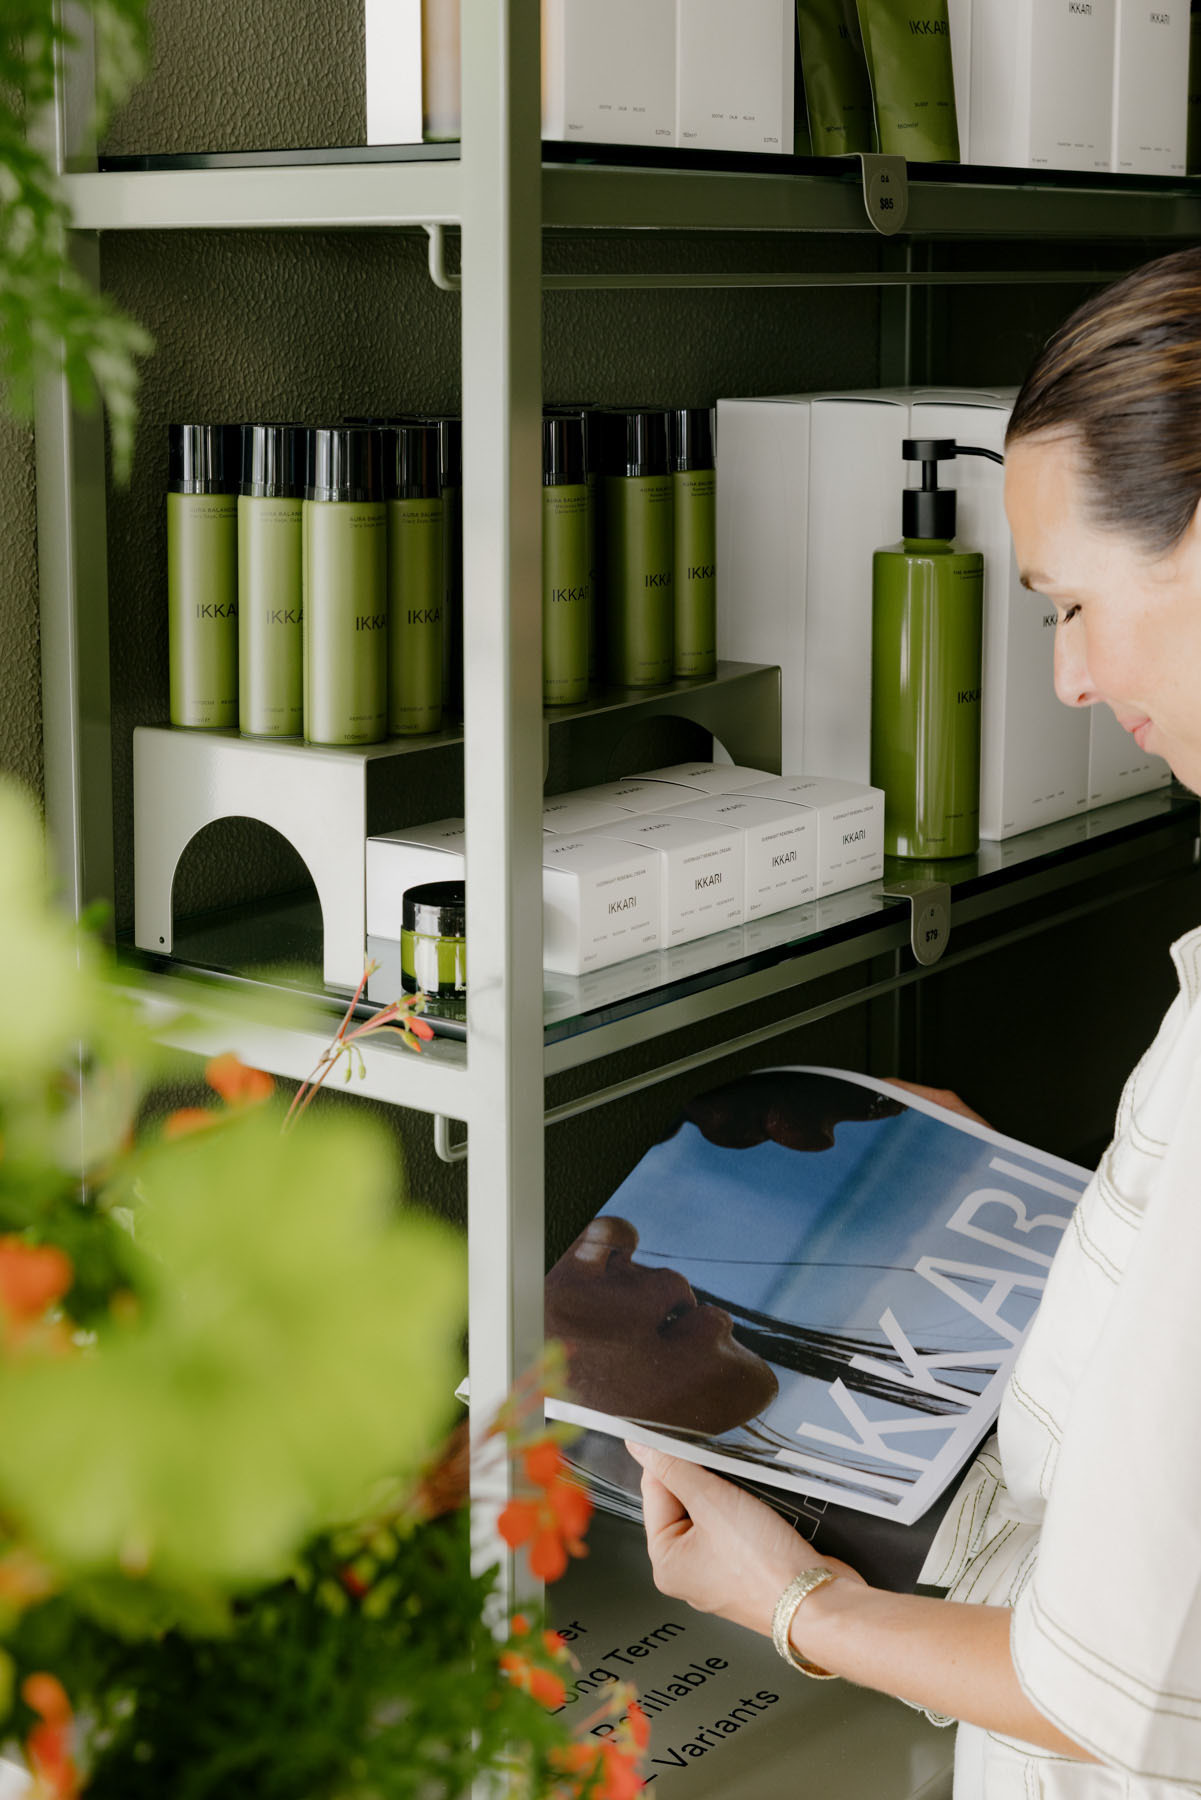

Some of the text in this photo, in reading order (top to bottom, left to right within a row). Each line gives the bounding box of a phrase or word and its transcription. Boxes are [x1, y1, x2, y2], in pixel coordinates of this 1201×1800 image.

[909, 20, 947, 35] IKKAR
[645, 573, 671, 588] IKKA
[688, 565, 715, 580] IKKA
[197, 603, 237, 619] IKKA
[266, 608, 303, 624] IKKA
[408, 608, 440, 624] IKKA
[356, 614, 385, 631] IKKA
[842, 829, 866, 846] IKKARI
[772, 850, 797, 867] IKKARI
[695, 872, 722, 890] IKKARI
[608, 896, 637, 915] IKKARI
[774, 1157, 1093, 1503] IKKARI
[601, 1622, 686, 1665] Term
[650, 1690, 780, 1768] Variants
